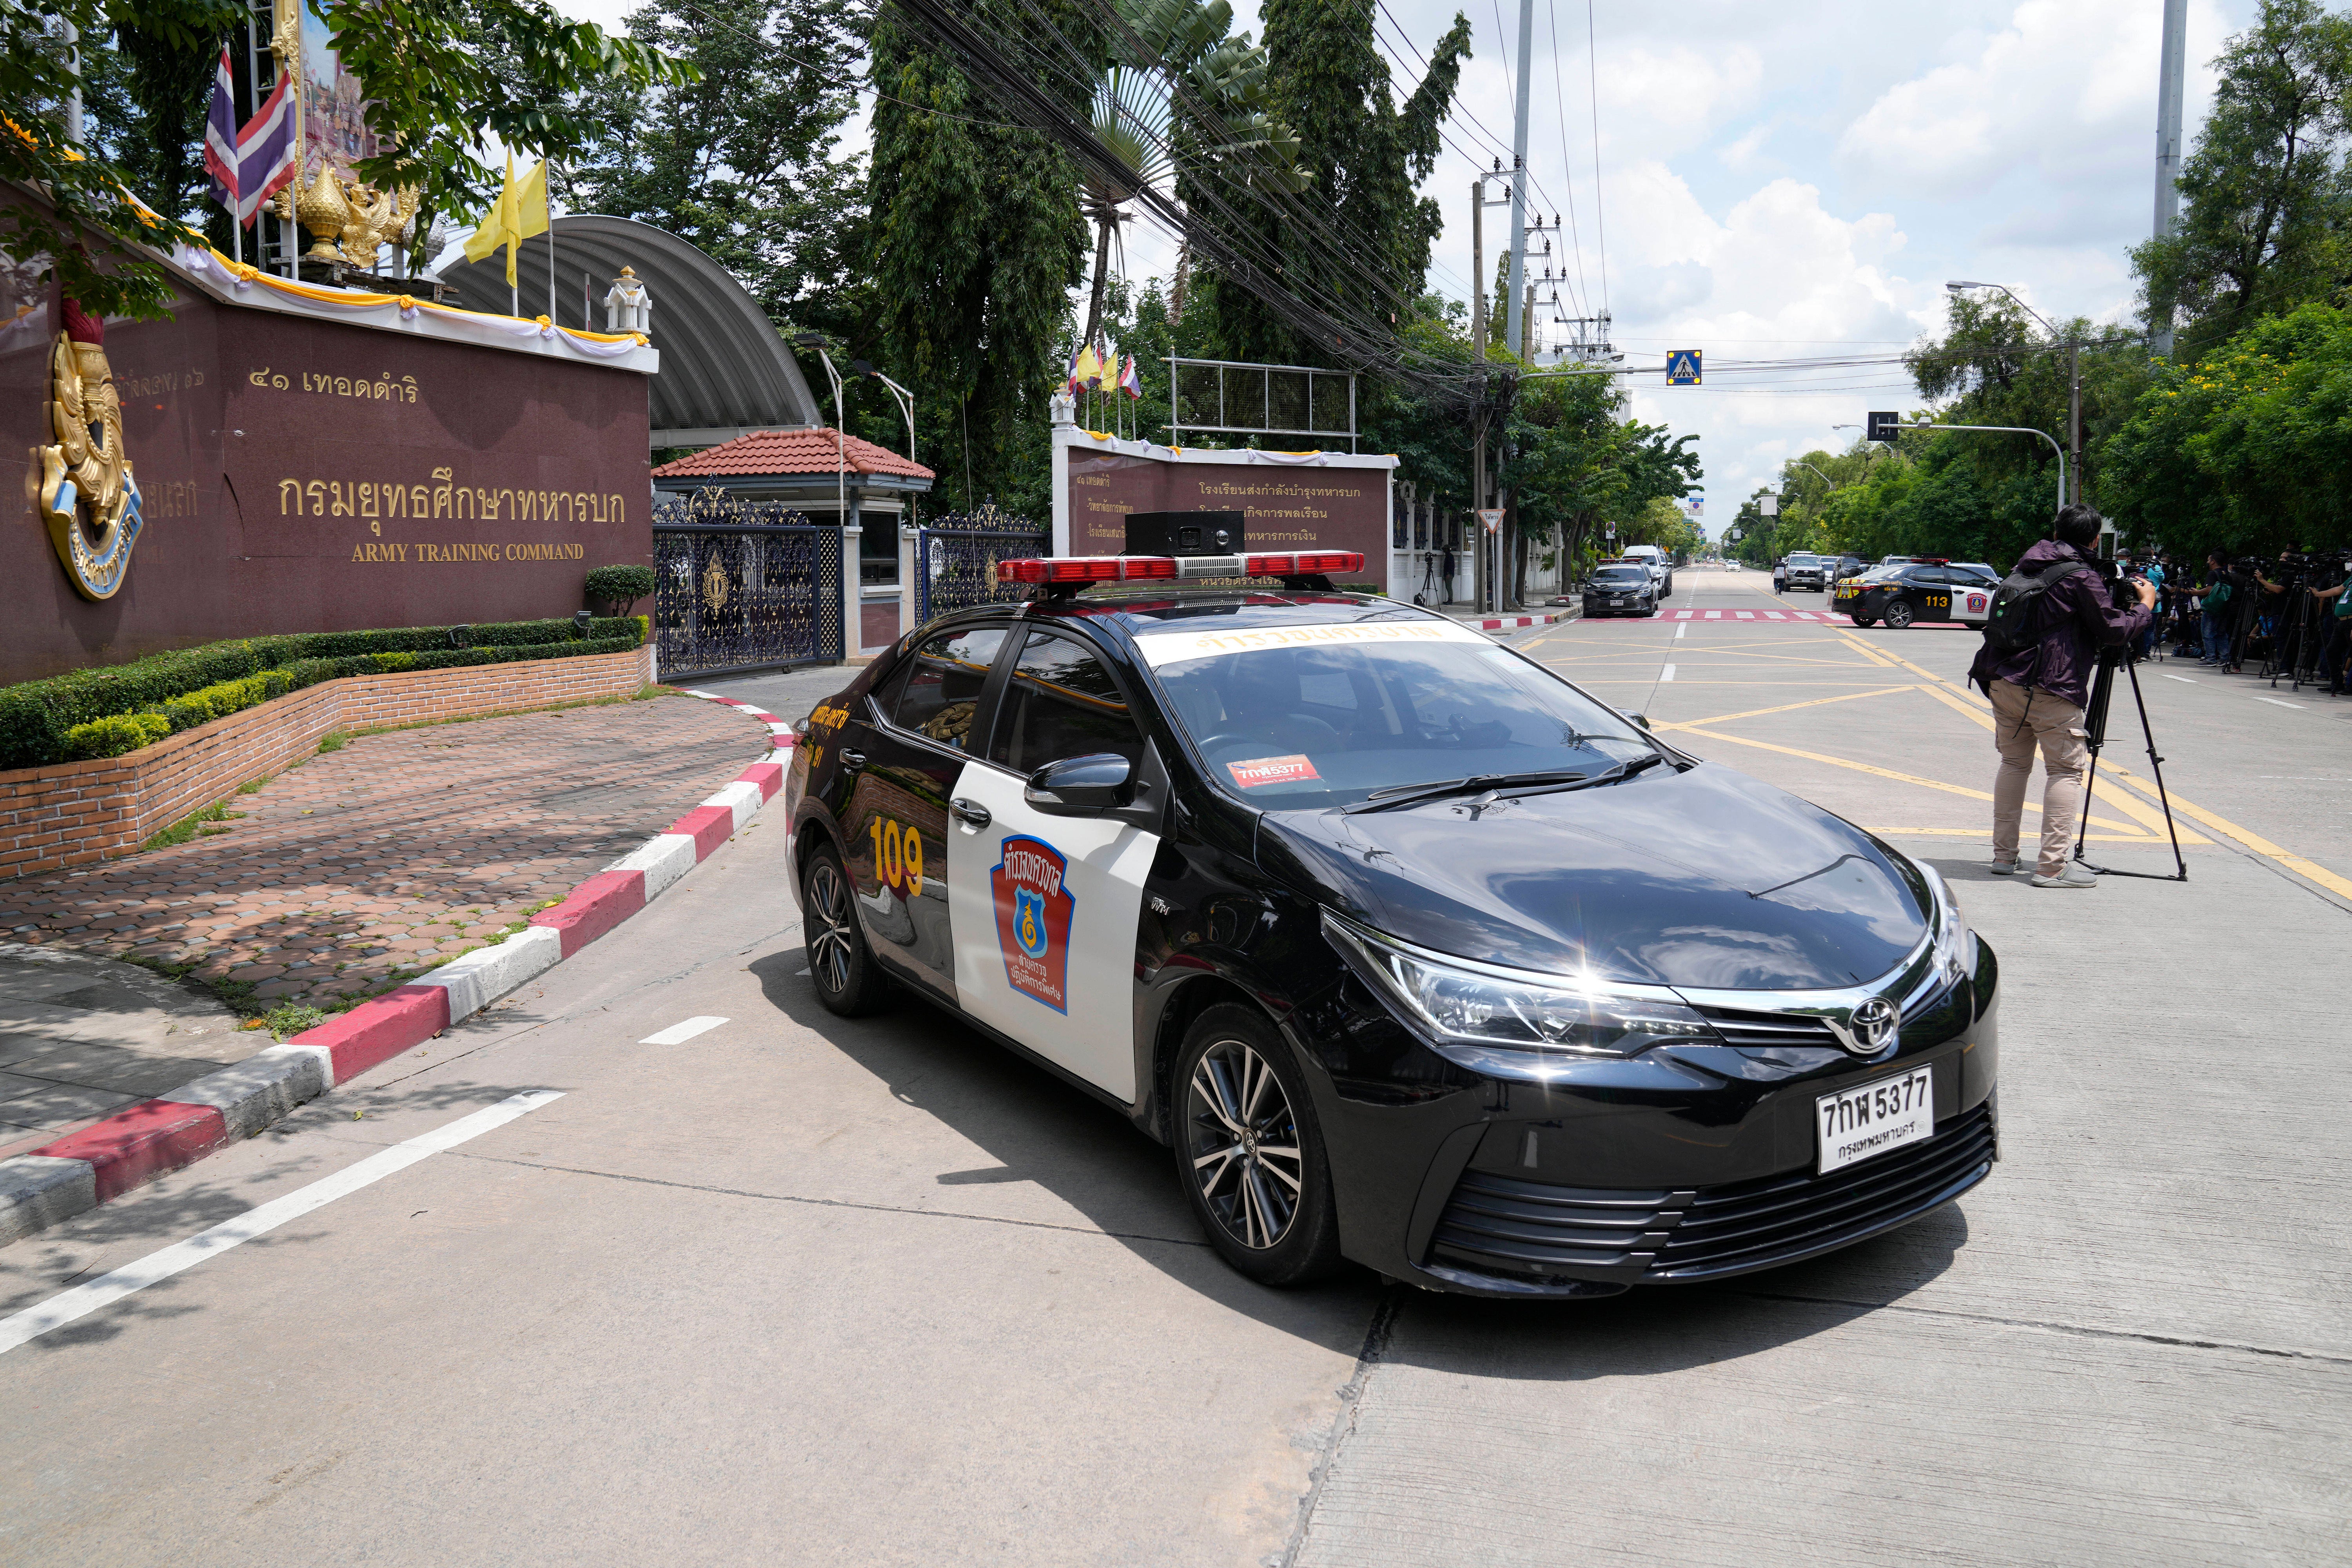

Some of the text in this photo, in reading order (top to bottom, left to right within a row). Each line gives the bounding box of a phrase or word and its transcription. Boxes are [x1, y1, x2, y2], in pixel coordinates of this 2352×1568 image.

[249, 367, 419, 403] ๔๑ เทอดดำริ
[1086, 473, 1110, 487] เทอดดำริ
[1199, 482, 1361, 499] โรงเรียนส่งกำลังบำรุงทหารบก
[278, 466, 625, 537] กรมยุทธศึกษาทหารบก
[351, 543, 584, 563] ARMY TRAINING COMMAND
[1926, 596, 1948, 607] 113
[813, 745, 824, 768] 191
[870, 816, 922, 897] 109
[1003, 843, 1062, 898] ตำรวจนครบาล
[1875, 1075, 1927, 1119] 5377
[1838, 1121, 1915, 1160] กรุงเทพมหานคร
